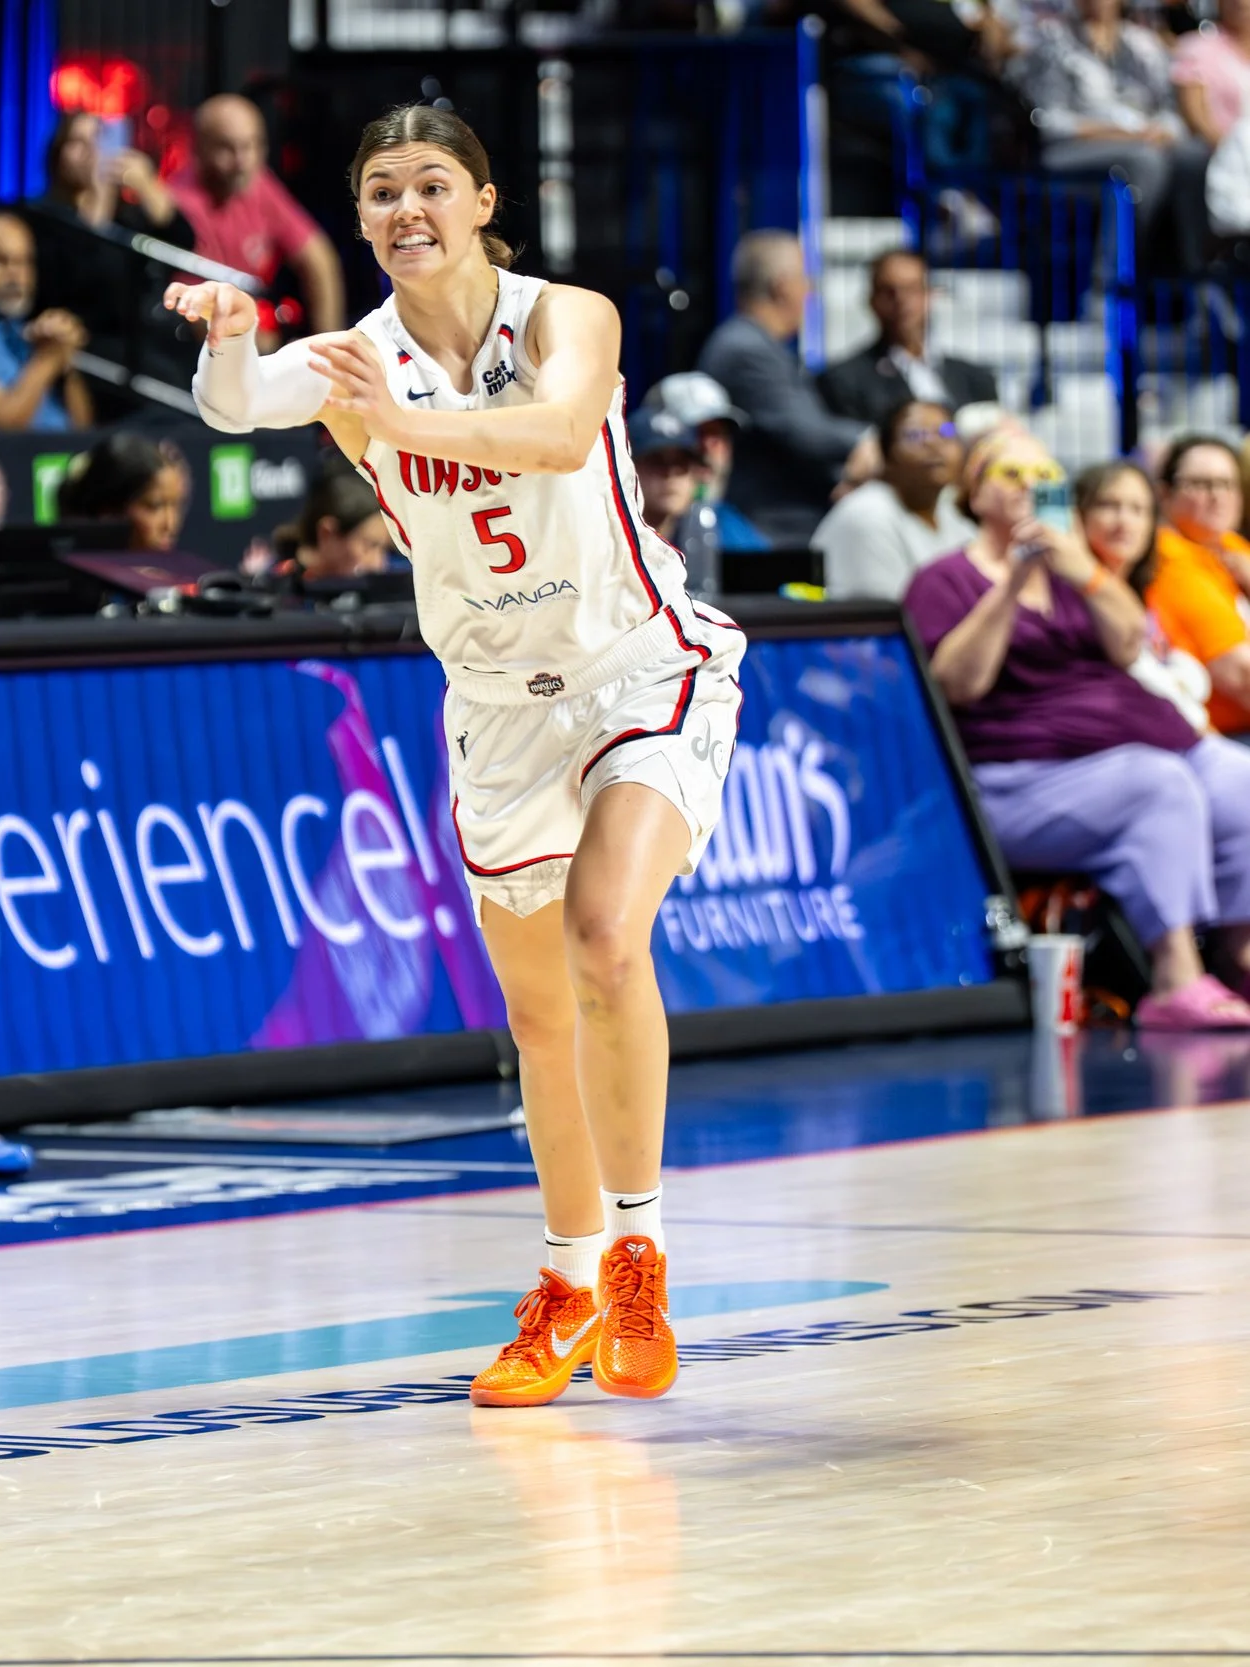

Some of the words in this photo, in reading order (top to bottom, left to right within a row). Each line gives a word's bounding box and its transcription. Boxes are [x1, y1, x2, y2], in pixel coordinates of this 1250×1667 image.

[471, 505, 526, 574] 5
[483, 579, 578, 611] VANDA
[659, 883, 866, 954] FURNITURE
